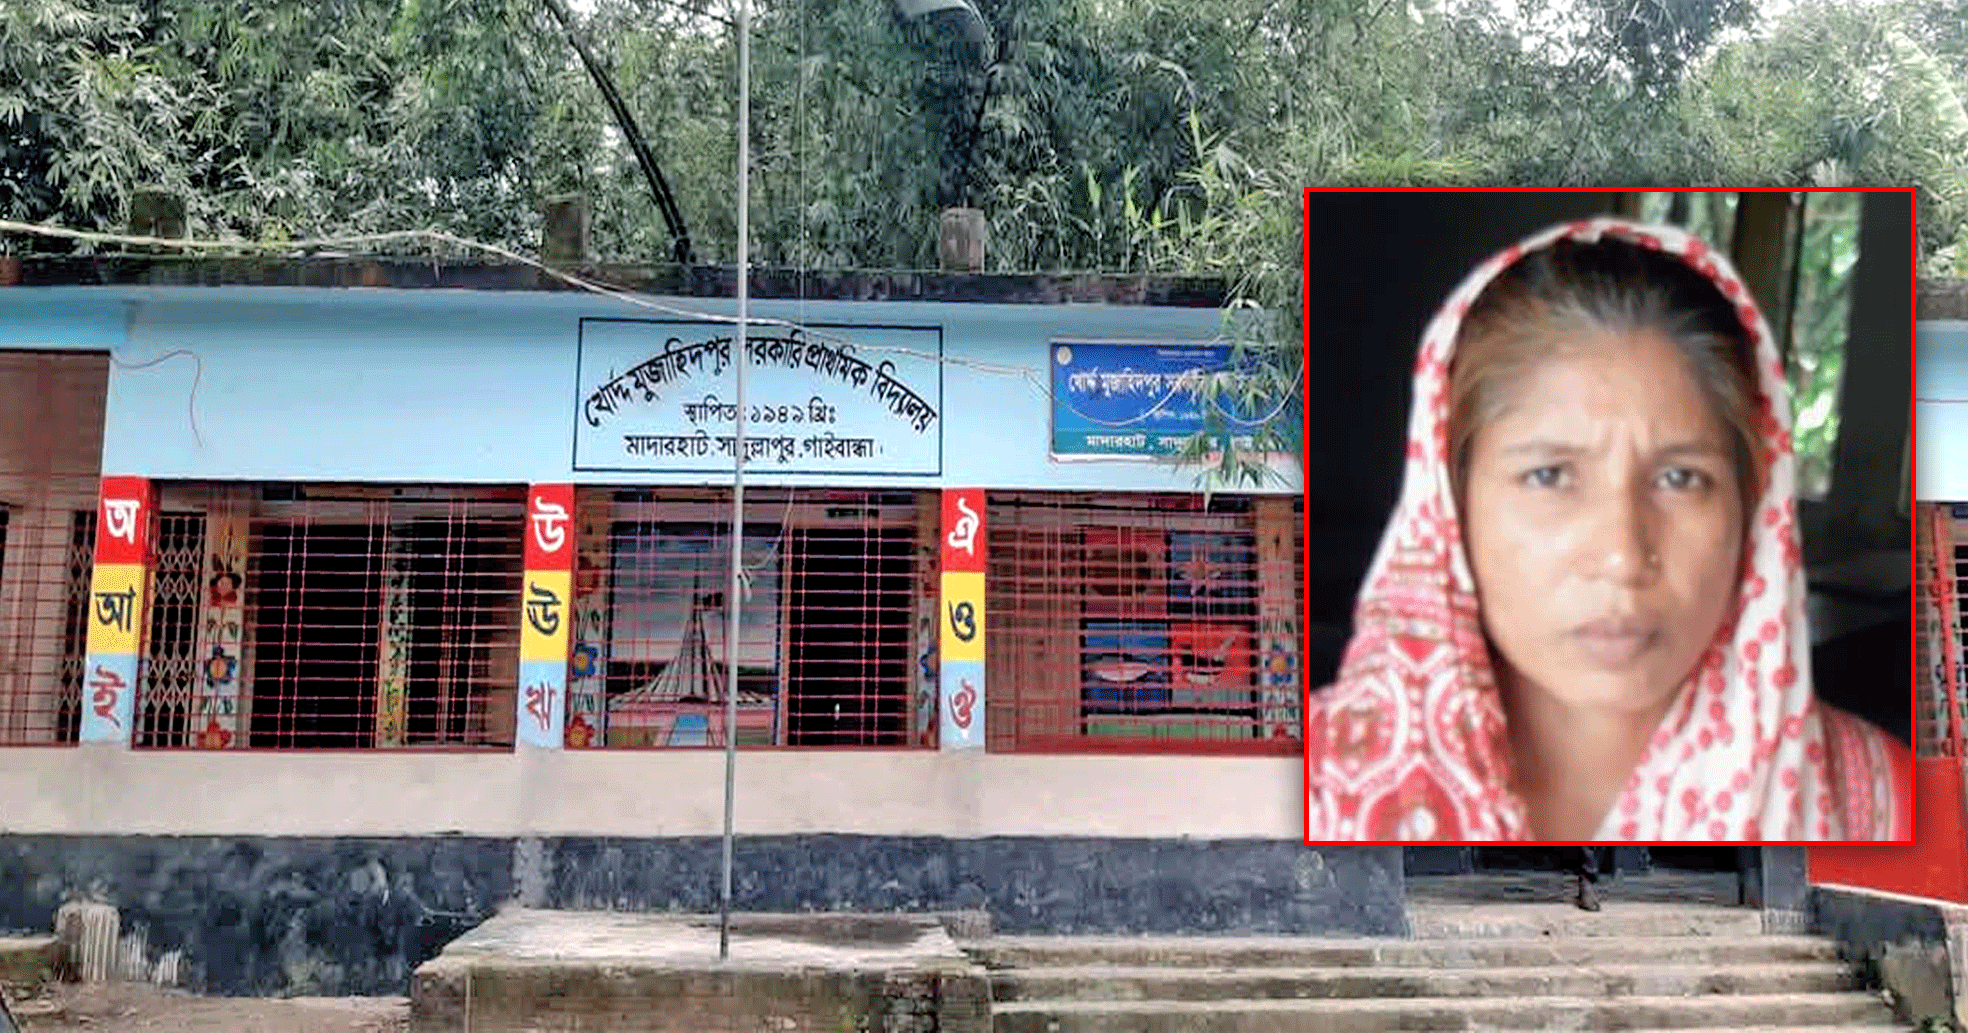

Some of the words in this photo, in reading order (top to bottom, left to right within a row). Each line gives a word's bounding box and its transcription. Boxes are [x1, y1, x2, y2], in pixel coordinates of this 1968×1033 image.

[104, 499, 140, 545] অ
[532, 496, 570, 552] উ
[948, 497, 980, 557] ঐ
[95, 583, 136, 633] আ
[526, 581, 562, 636] ঊ
[948, 600, 977, 643] ও
[90, 664, 127, 729] ই
